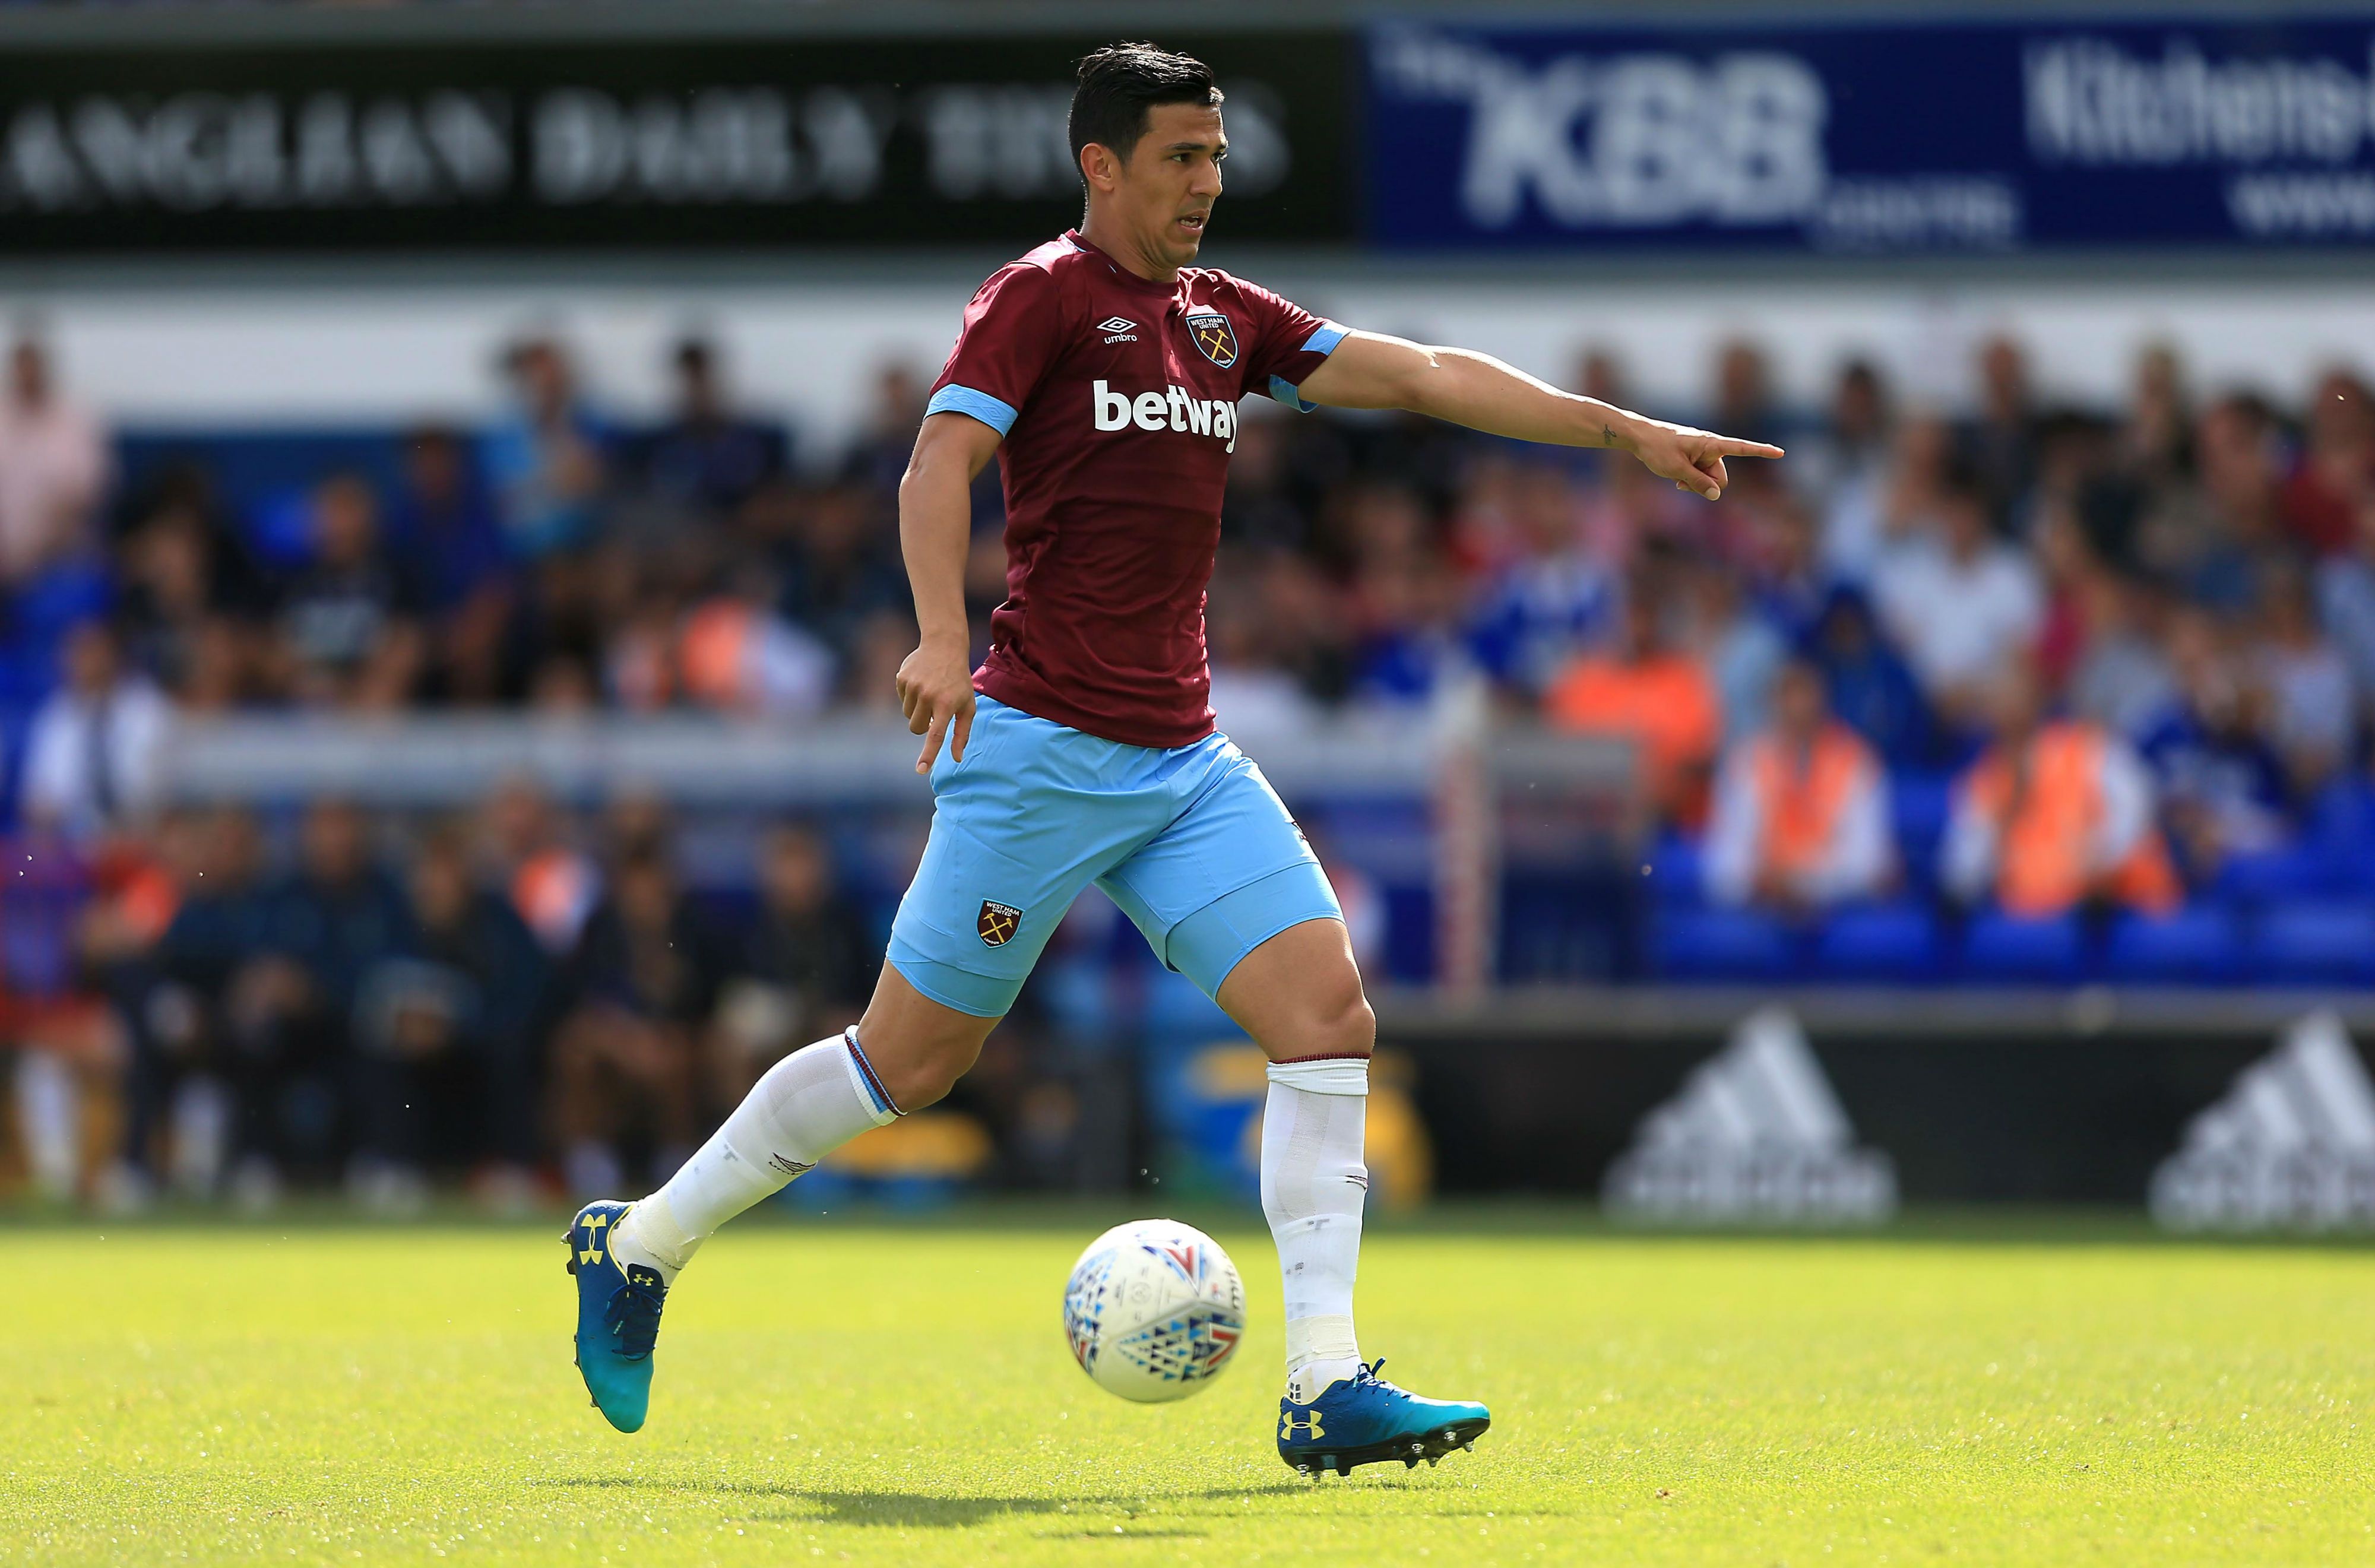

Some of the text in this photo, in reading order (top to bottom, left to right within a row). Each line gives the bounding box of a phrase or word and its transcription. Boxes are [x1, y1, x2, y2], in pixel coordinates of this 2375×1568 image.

[1464, 50, 1828, 226] KBB
[1104, 332, 1138, 344] umbro
[1093, 379, 1238, 454] betway
[986, 901, 1020, 917] WEST HAM
[992, 908, 1012, 917] UNITED
